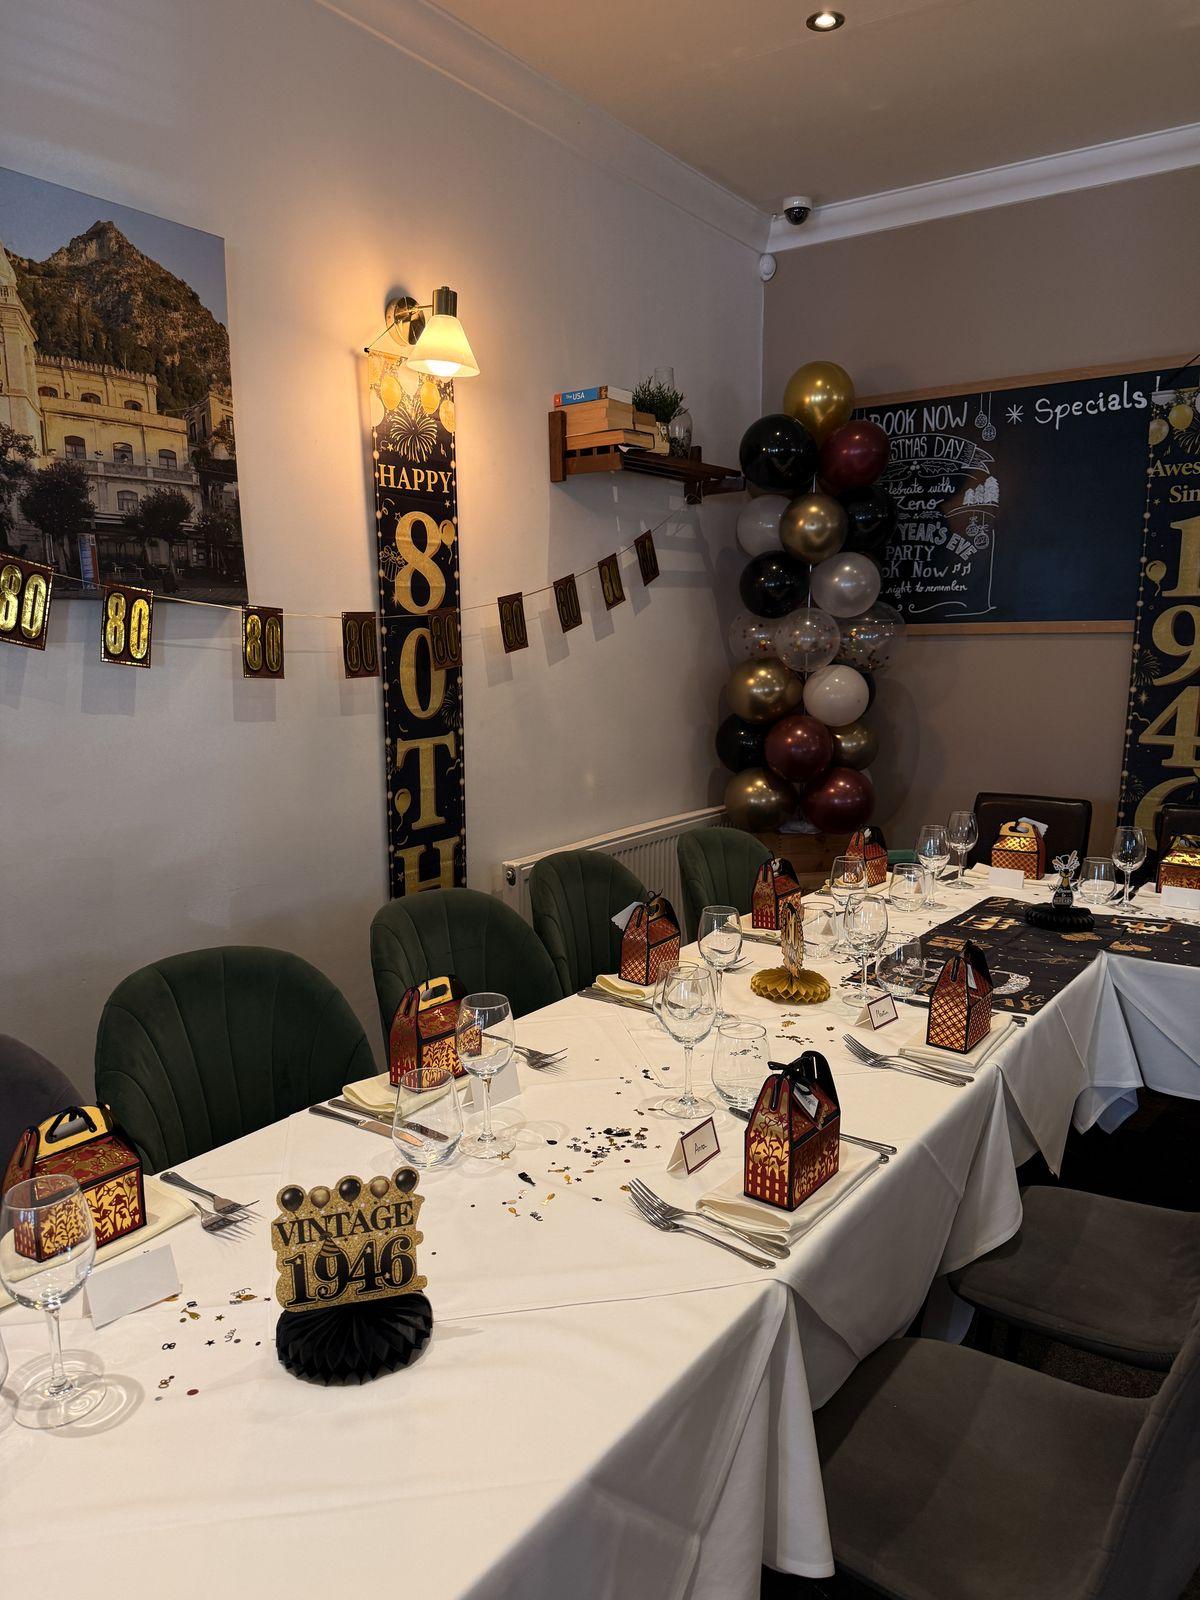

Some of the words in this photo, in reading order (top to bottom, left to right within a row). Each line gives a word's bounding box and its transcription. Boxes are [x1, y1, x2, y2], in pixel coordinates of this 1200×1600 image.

[572, 391, 585, 400] USA
[922, 401, 968, 433] NOW
[889, 436, 928, 462] STMAS
[933, 436, 965, 460] DAY
[378, 463, 452, 494] HAPPY
[886, 477, 924, 495] lebrate
[928, 476, 955, 493] with
[892, 496, 944, 511] Zeno
[884, 544, 935, 561] PARTY
[896, 521, 948, 546] YEAR'S
[946, 533, 978, 561] EVE
[0, 563, 48, 640] 80
[886, 581, 912, 599] night
[925, 580, 968, 593] remember
[105, 592, 150, 660] 80
[246, 614, 281, 672] 80
[432, 614, 460, 664] 80
[500, 600, 527, 649] 80
[346, 619, 377, 673] 80
[273, 1200, 414, 1247] VINTAGE
[283, 1233, 417, 1308] 1946
